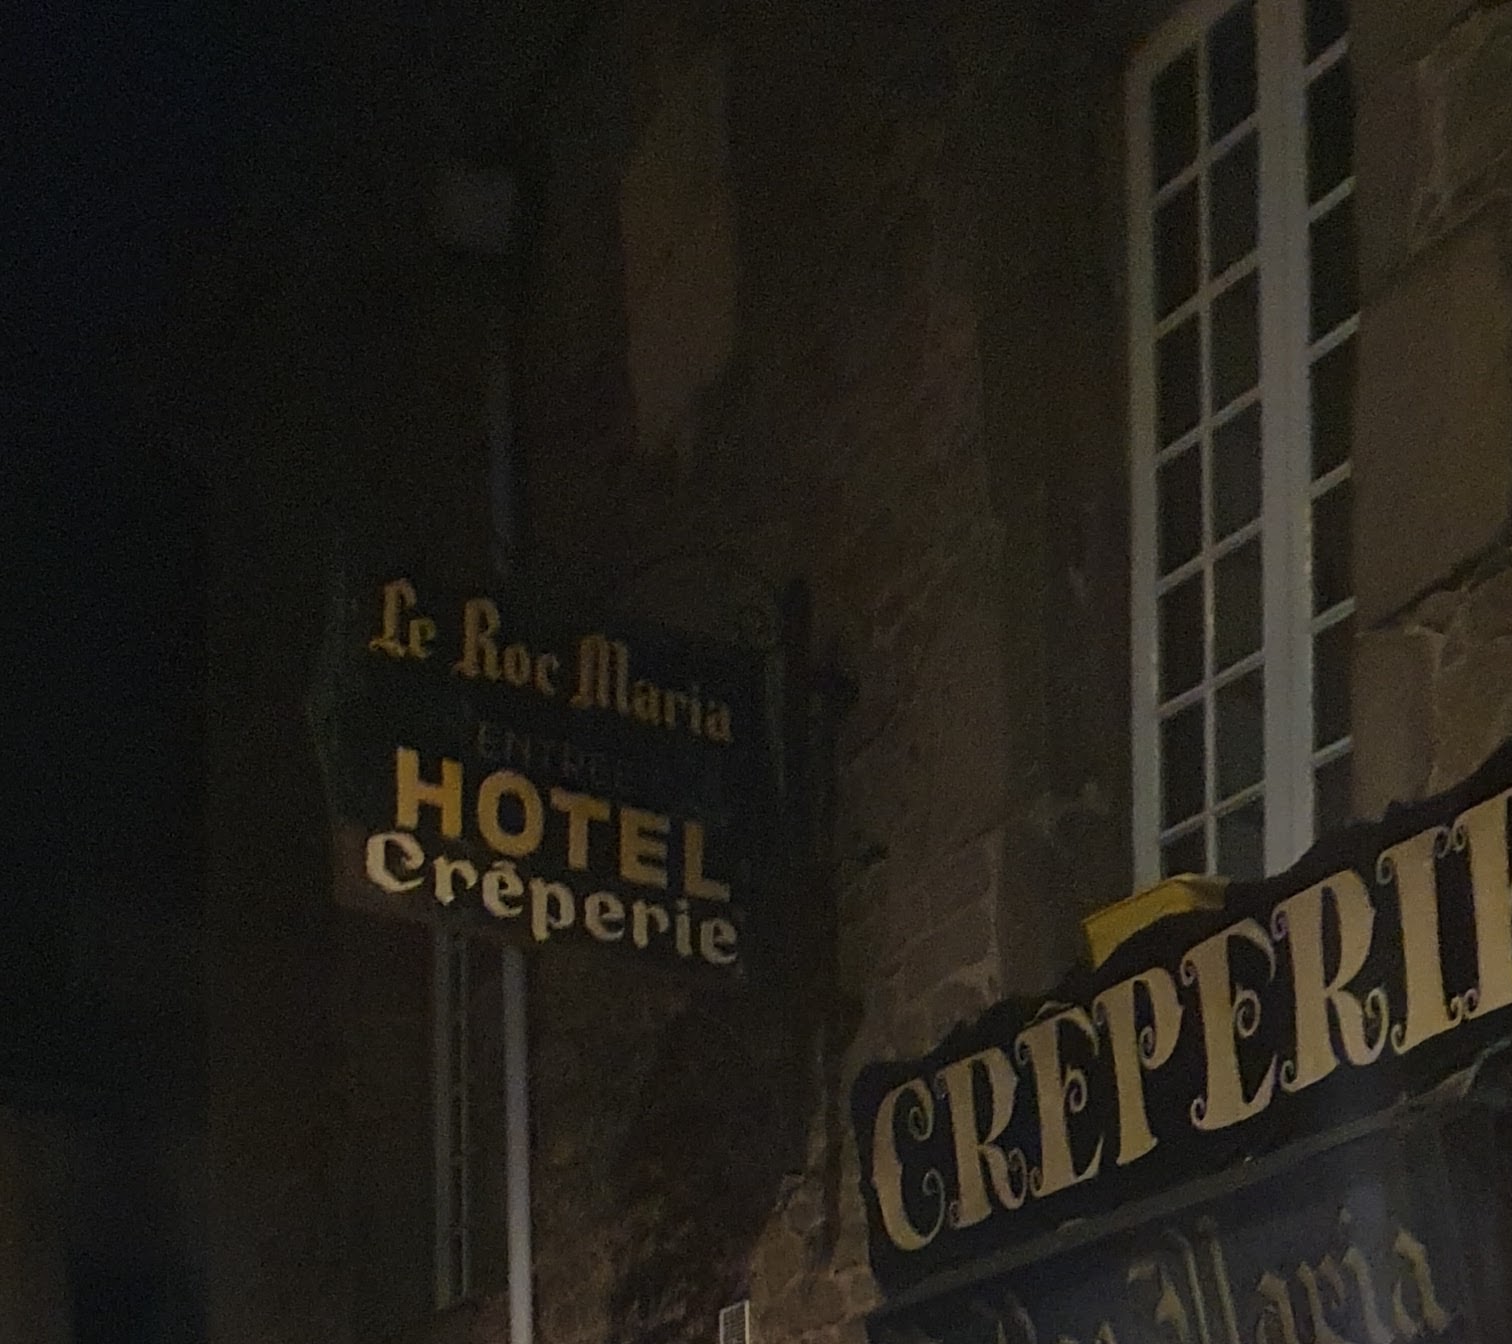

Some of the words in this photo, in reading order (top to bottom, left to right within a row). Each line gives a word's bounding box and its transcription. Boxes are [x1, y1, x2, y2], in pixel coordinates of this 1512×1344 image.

[369, 577, 437, 659] Le
[451, 597, 560, 696] Roc
[568, 633, 734, 745] Maria
[365, 831, 739, 964] Crêperie
[393, 745, 731, 902] HOTEL
